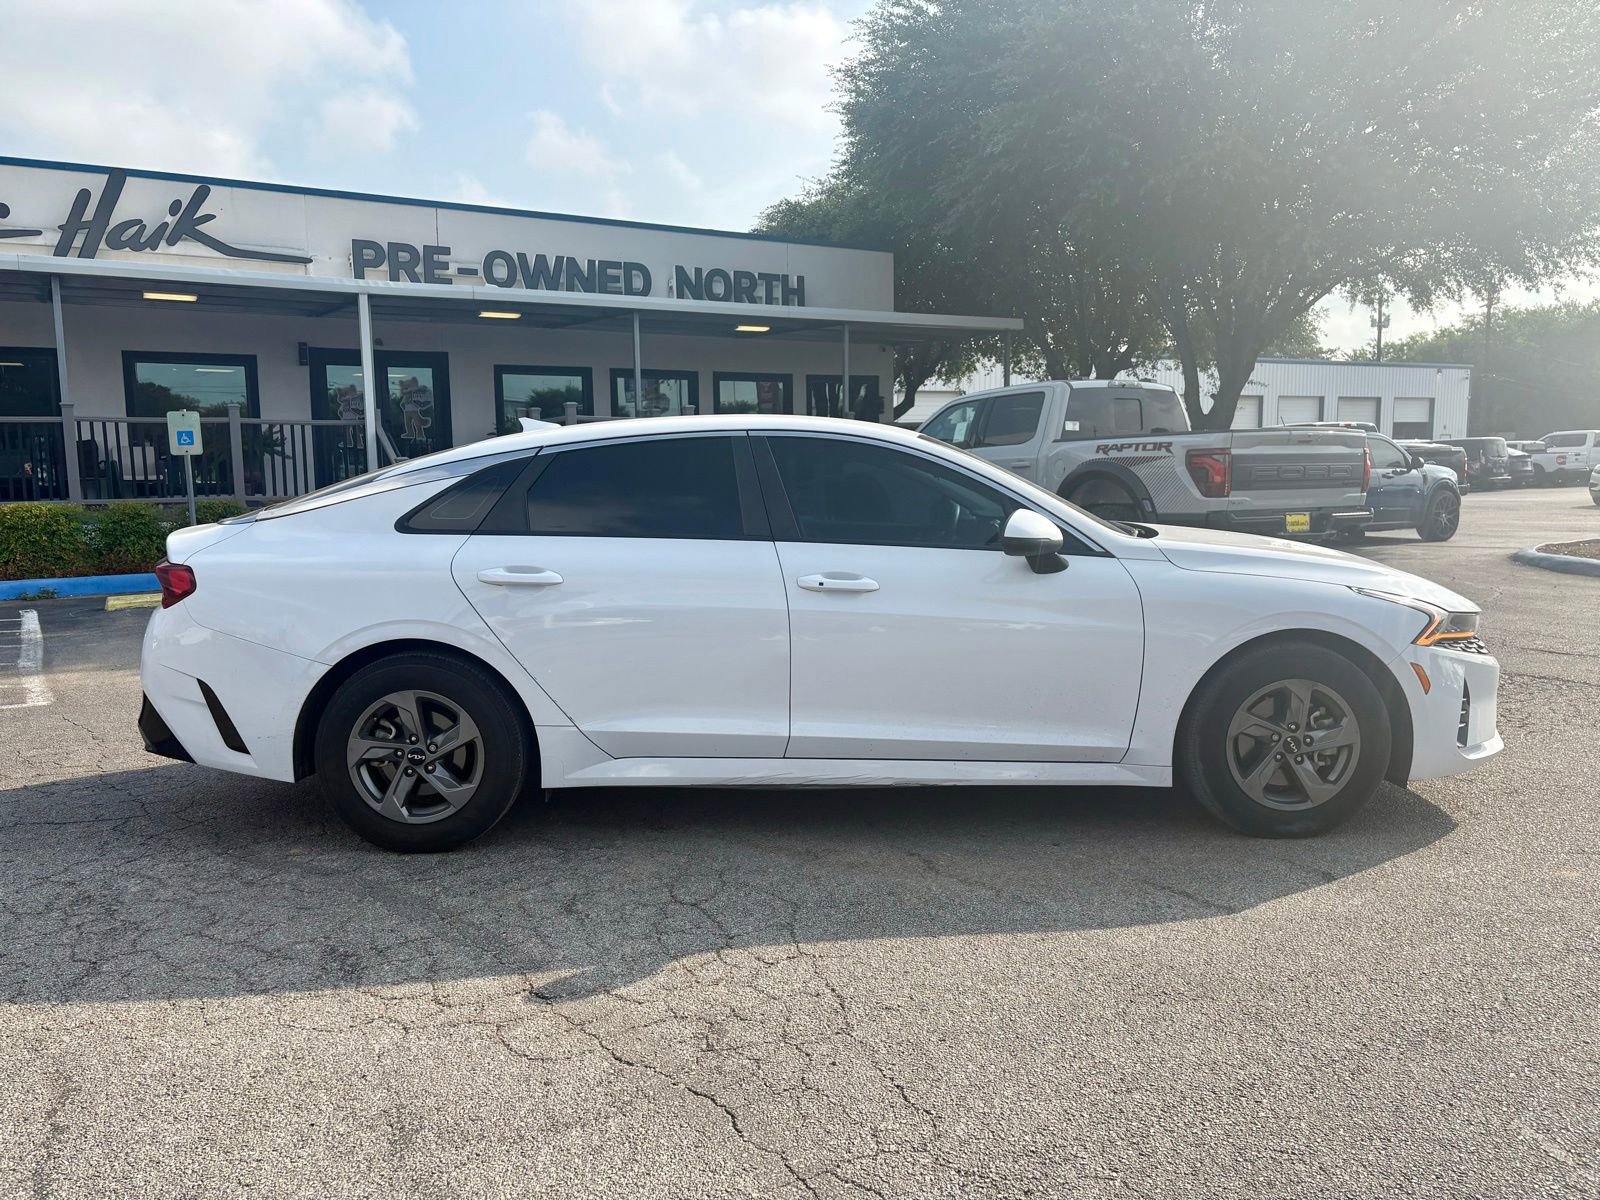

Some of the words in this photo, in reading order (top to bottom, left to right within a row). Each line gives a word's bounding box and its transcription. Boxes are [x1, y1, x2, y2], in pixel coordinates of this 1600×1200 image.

[53, 168, 314, 264] Haik
[351, 239, 652, 297] PRE-OWNED
[674, 265, 805, 307] NORTH
[1096, 442, 1174, 456] RAPTOR
[1252, 465, 1351, 480] FORD
